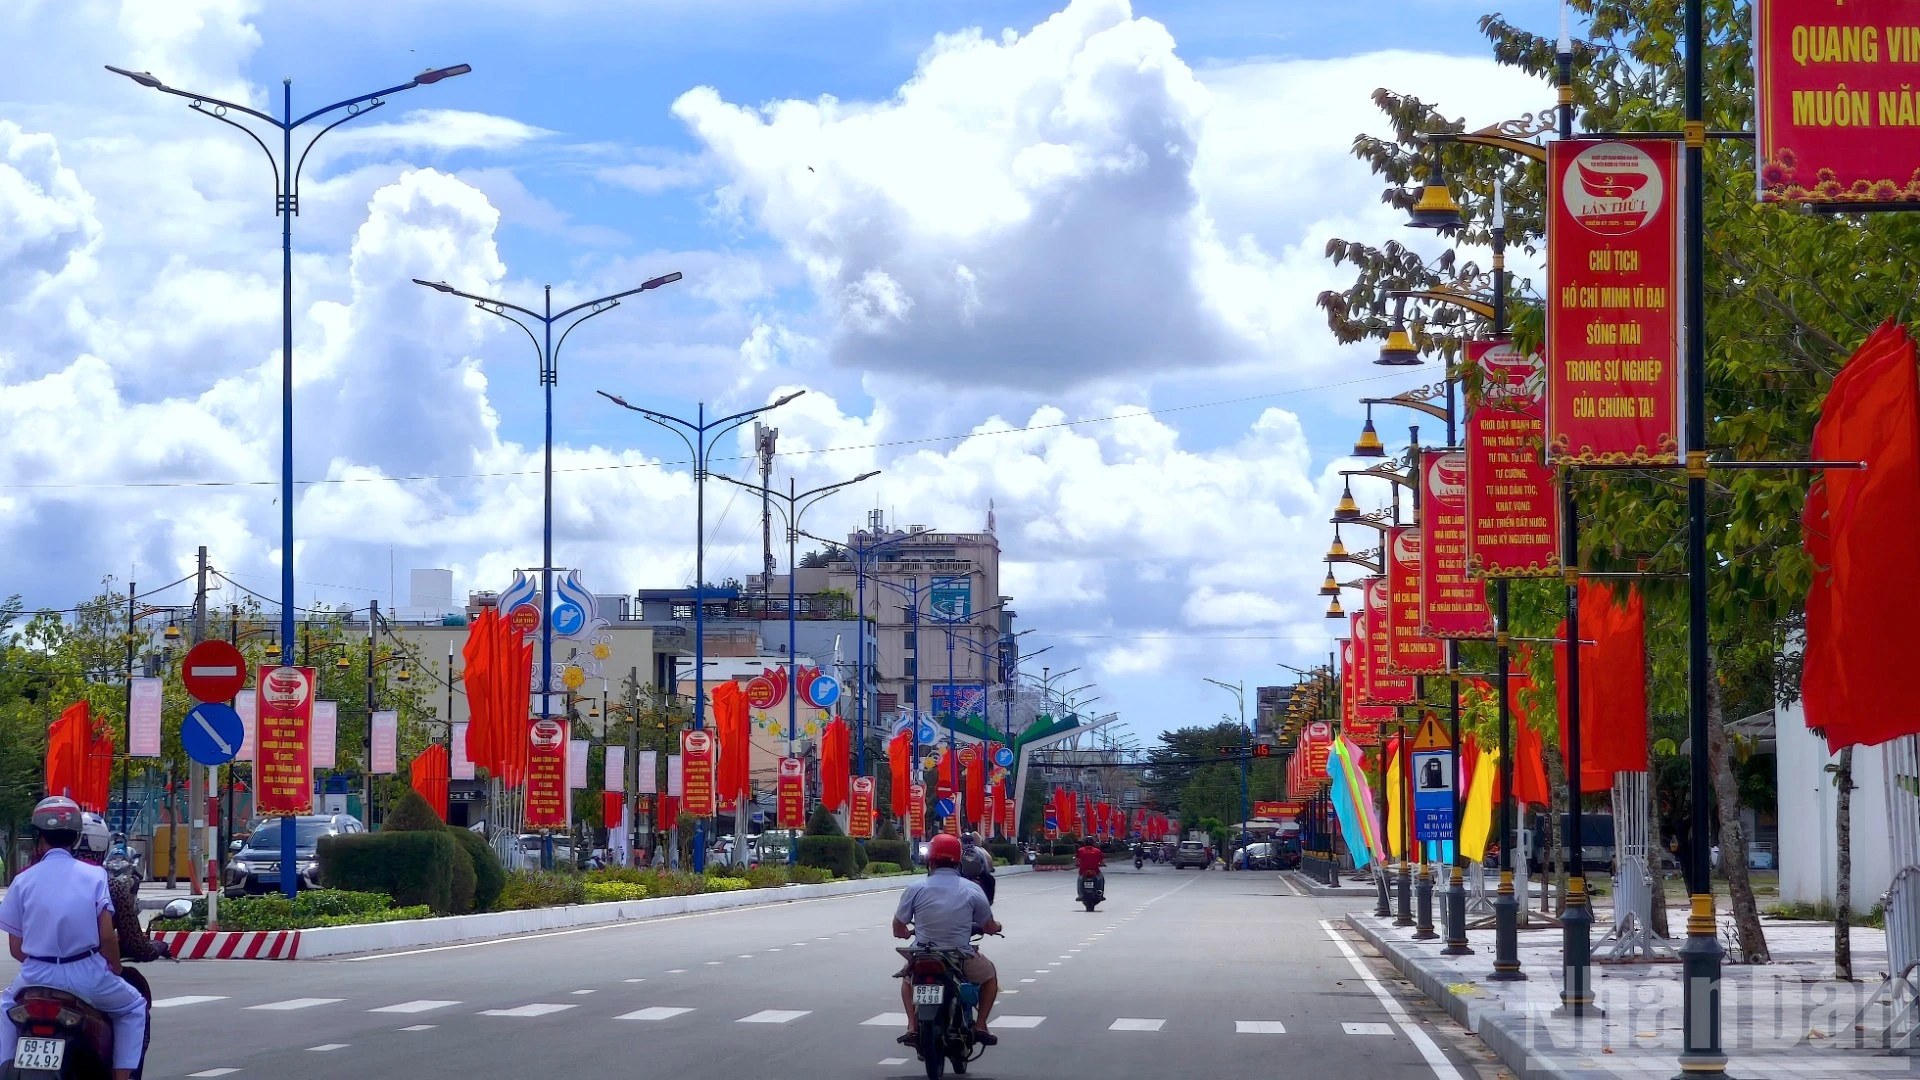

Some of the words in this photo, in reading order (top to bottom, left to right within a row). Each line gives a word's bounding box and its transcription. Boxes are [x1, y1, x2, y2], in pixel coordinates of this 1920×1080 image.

[1792, 25, 1878, 66] QUANG
[1792, 83, 1870, 126] MUÔN
[1589, 243, 1611, 271] CHỦ
[1614, 250, 1638, 276] TỊCH
[1580, 283, 1598, 308] CHÍ
[1601, 287, 1630, 308] MINH
[1633, 284, 1644, 308] VĨ
[1646, 287, 1665, 312] ĐẠI
[1586, 316, 1616, 345] SỐNG
[1620, 320, 1641, 345] MÃI
[1565, 360, 1602, 382] TRONG
[1604, 358, 1620, 386] SỰ
[1622, 356, 1662, 386] NGHIỆP
[1573, 390, 1596, 418] CỦA
[1598, 392, 1636, 418] CHÚNG
[1638, 397, 1654, 418] TA!
[18, 1054, 60, 1068] 424.92
[24, 1040, 56, 1054] 69-E1
